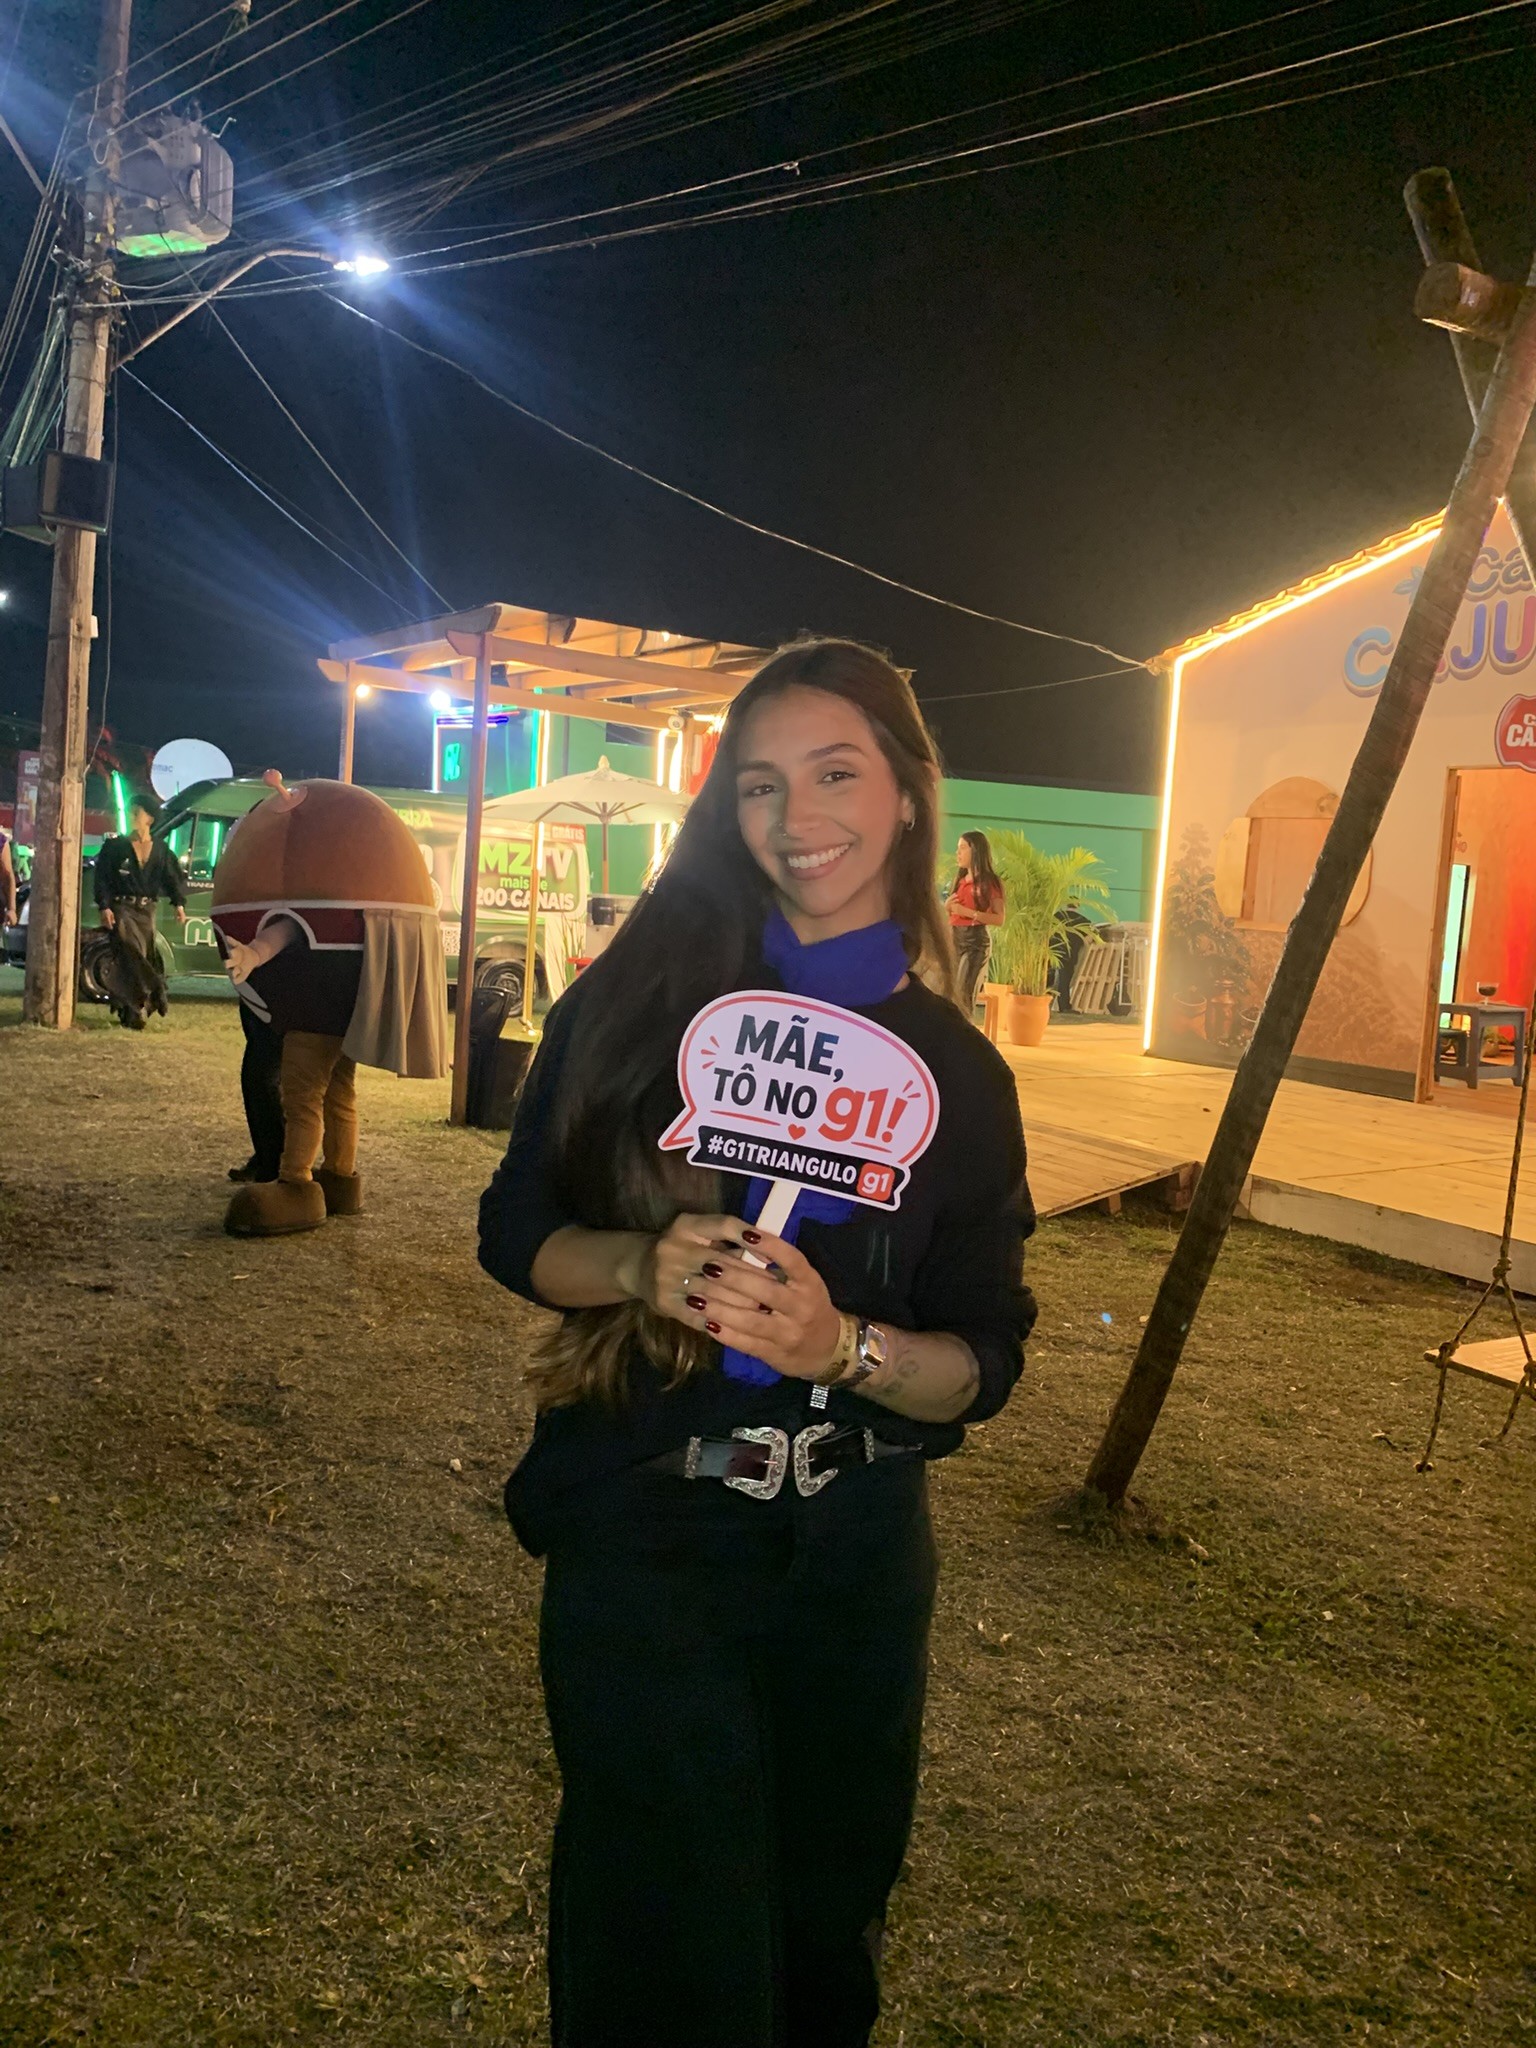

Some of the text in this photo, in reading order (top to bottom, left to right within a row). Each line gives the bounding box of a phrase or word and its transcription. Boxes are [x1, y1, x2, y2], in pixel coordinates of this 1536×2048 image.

[1344, 596, 1536, 697] CJU
[1506, 724, 1536, 747] CA
[501, 875, 529, 889] mais
[510, 889, 575, 910] CANAIS
[734, 1014, 844, 1083] MÃE,
[713, 1063, 908, 1143] TÔ NO g1!
[707, 1134, 890, 1194] #G1TRIANGULO g1
